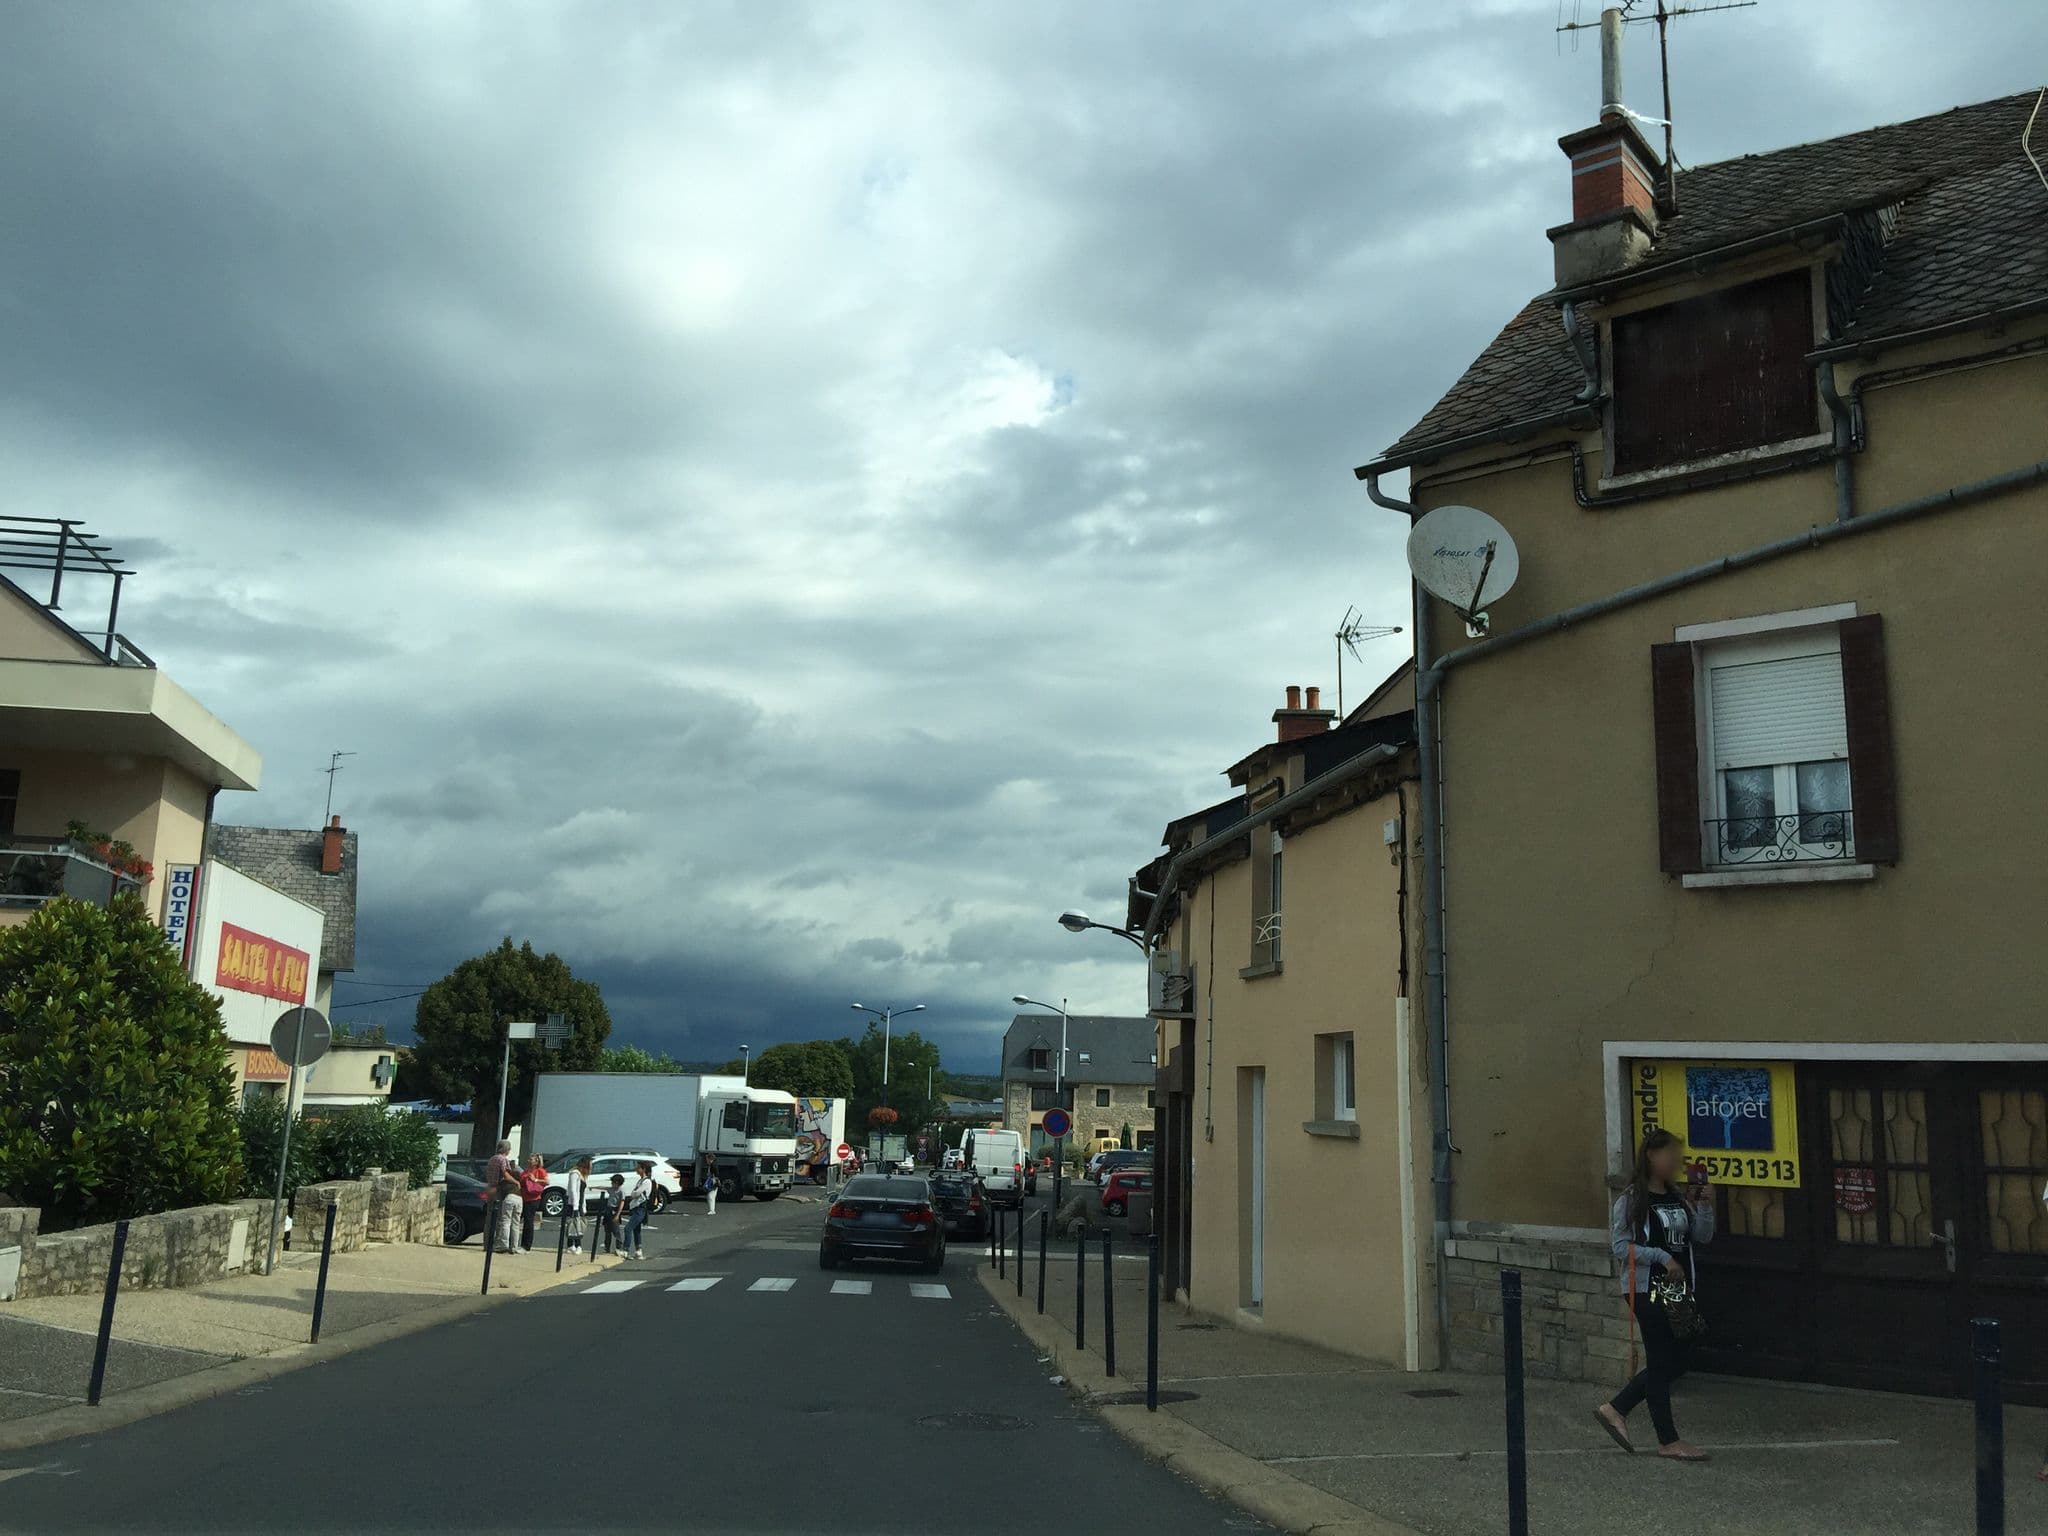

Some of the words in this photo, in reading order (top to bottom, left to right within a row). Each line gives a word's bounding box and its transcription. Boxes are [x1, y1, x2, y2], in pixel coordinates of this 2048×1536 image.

[166, 870, 193, 944] HOTEL
[220, 933, 269, 986] SALTEL
[282, 954, 307, 997] FILS
[1634, 1065, 1659, 1139] endre
[1690, 1093, 1768, 1119] laforêt
